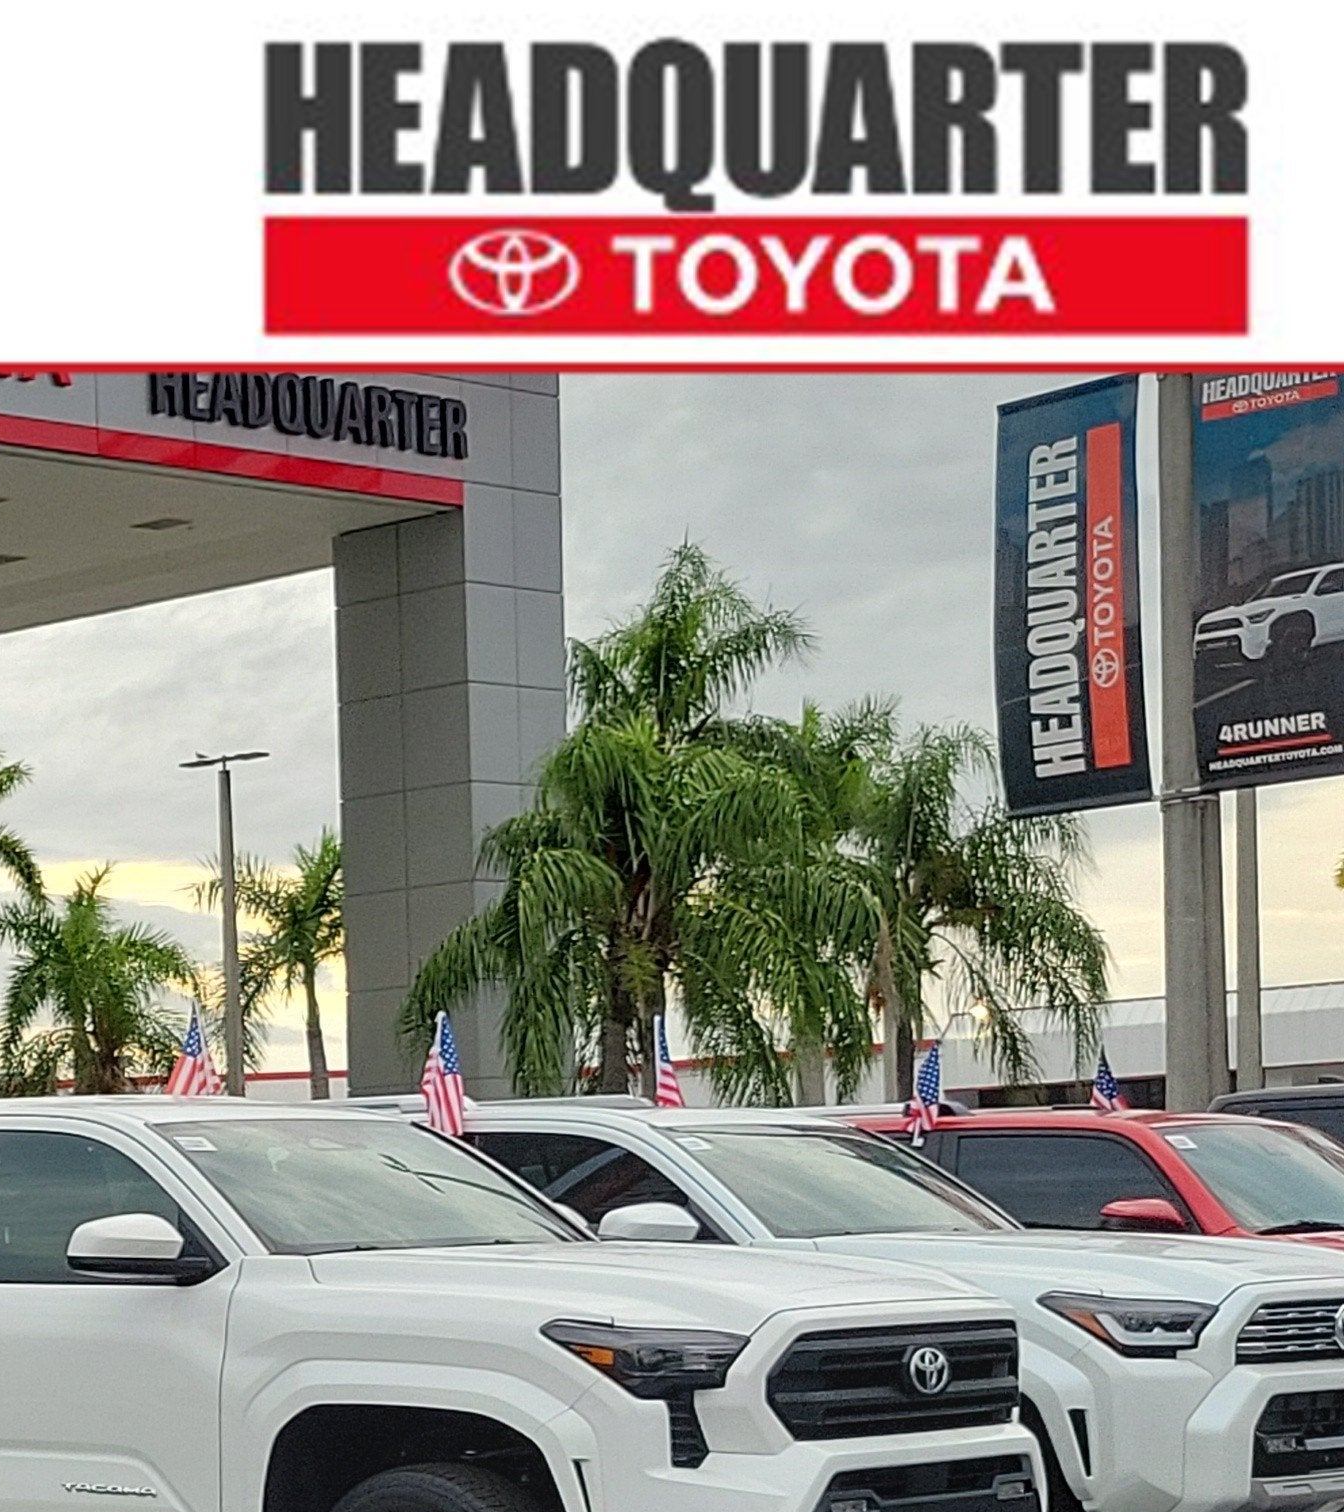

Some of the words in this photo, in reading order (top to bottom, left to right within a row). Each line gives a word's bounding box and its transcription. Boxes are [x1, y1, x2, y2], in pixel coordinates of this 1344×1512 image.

[1201, 372, 1336, 404] HEADQUAR
[1251, 390, 1300, 409] TOYOTA
[150, 372, 468, 460] HEADQUARTER
[1093, 516, 1115, 645] TOYOTA
[1027, 436, 1087, 778] HEADQUARTER
[1219, 712, 1326, 742] 4RUNNER
[1208, 743, 1344, 771] HEADQUARTERTOYOTA.COM
[62, 1483, 157, 1498] TACOMA
